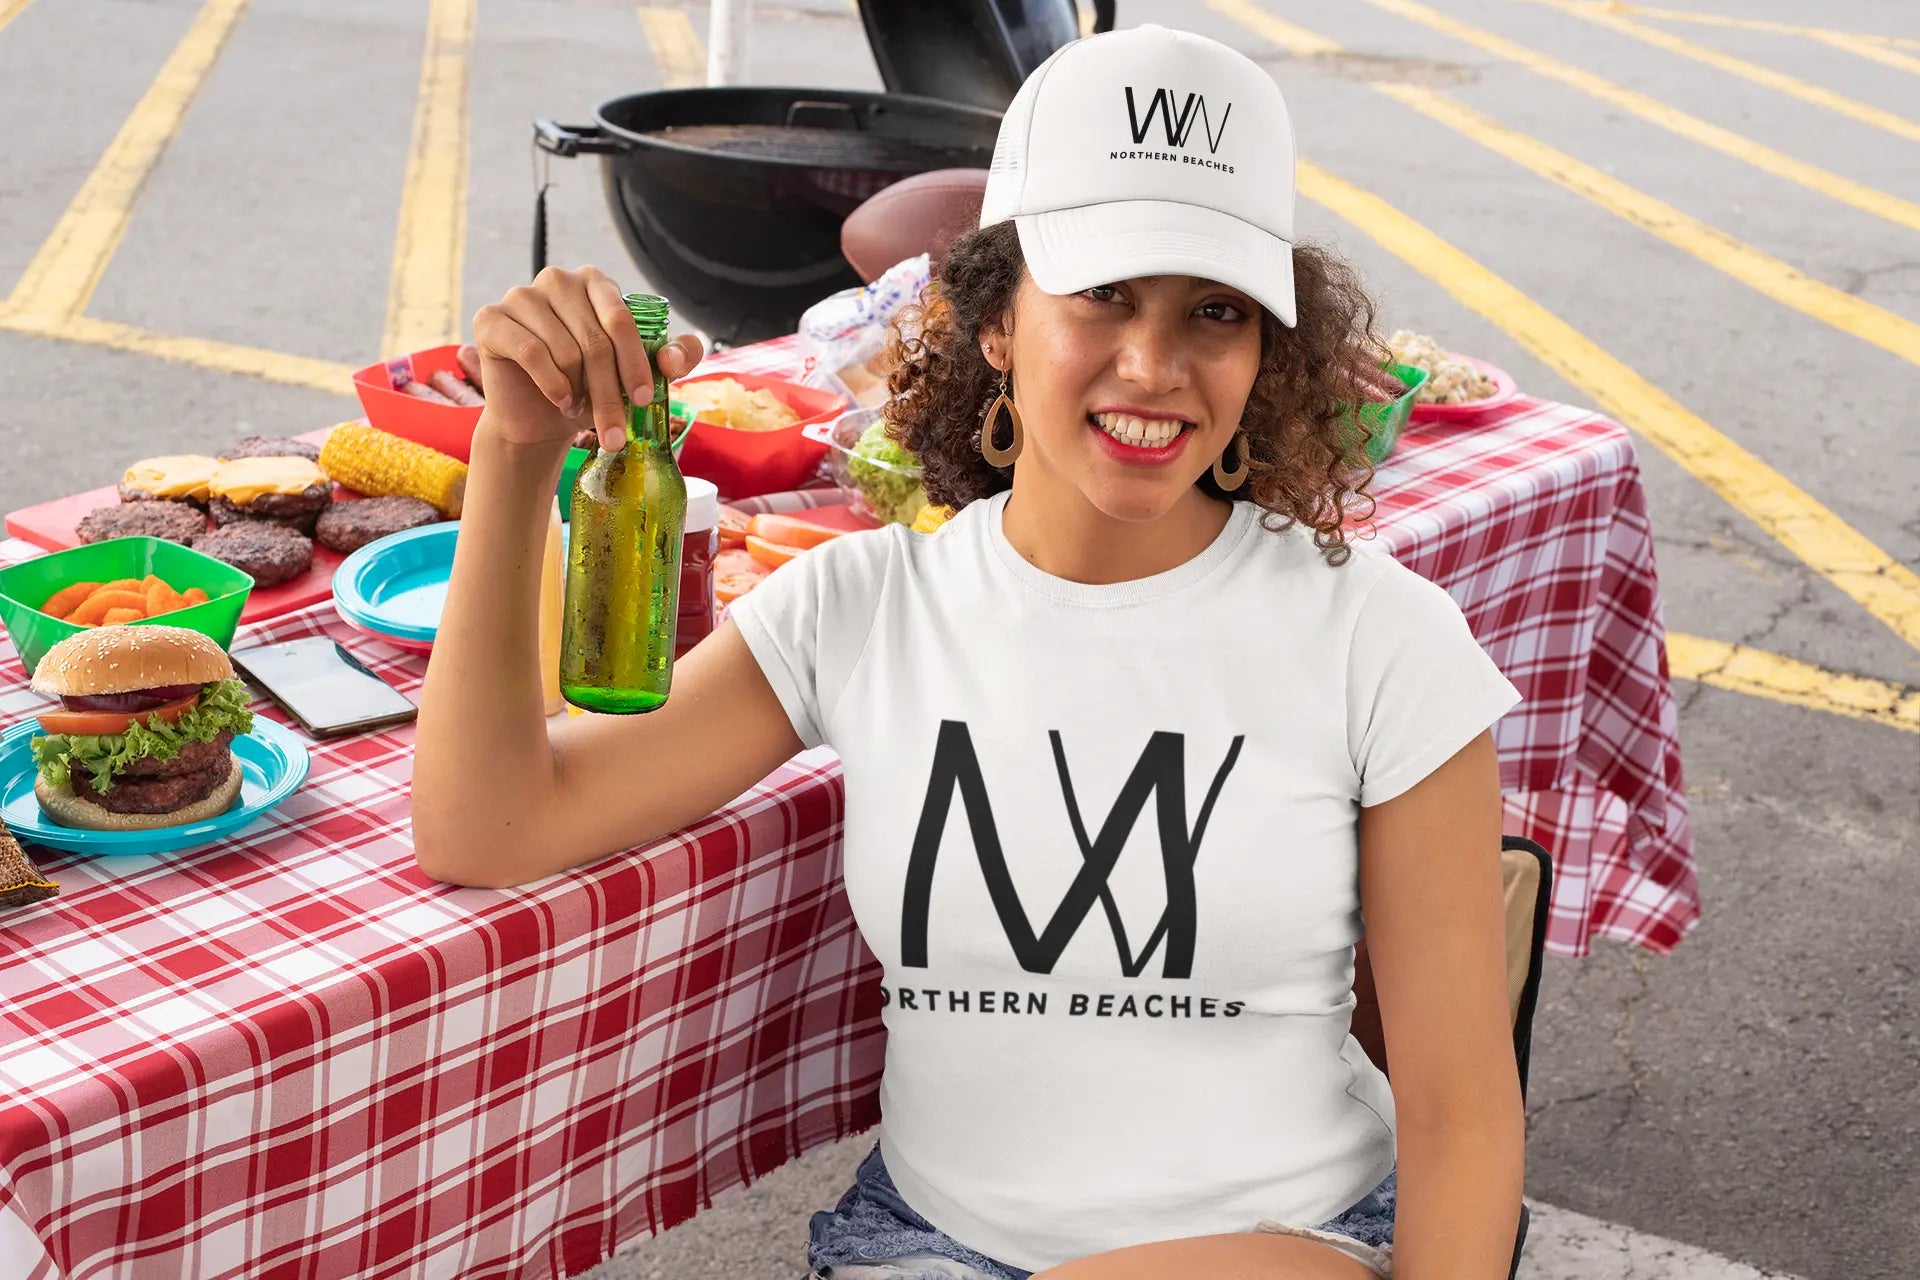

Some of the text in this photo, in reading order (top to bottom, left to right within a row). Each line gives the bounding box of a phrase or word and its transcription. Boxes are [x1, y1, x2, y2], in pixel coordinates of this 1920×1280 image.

[1110, 151, 1235, 174] NORTHERN BEACHES
[1069, 993, 1246, 1018] BEACHES
